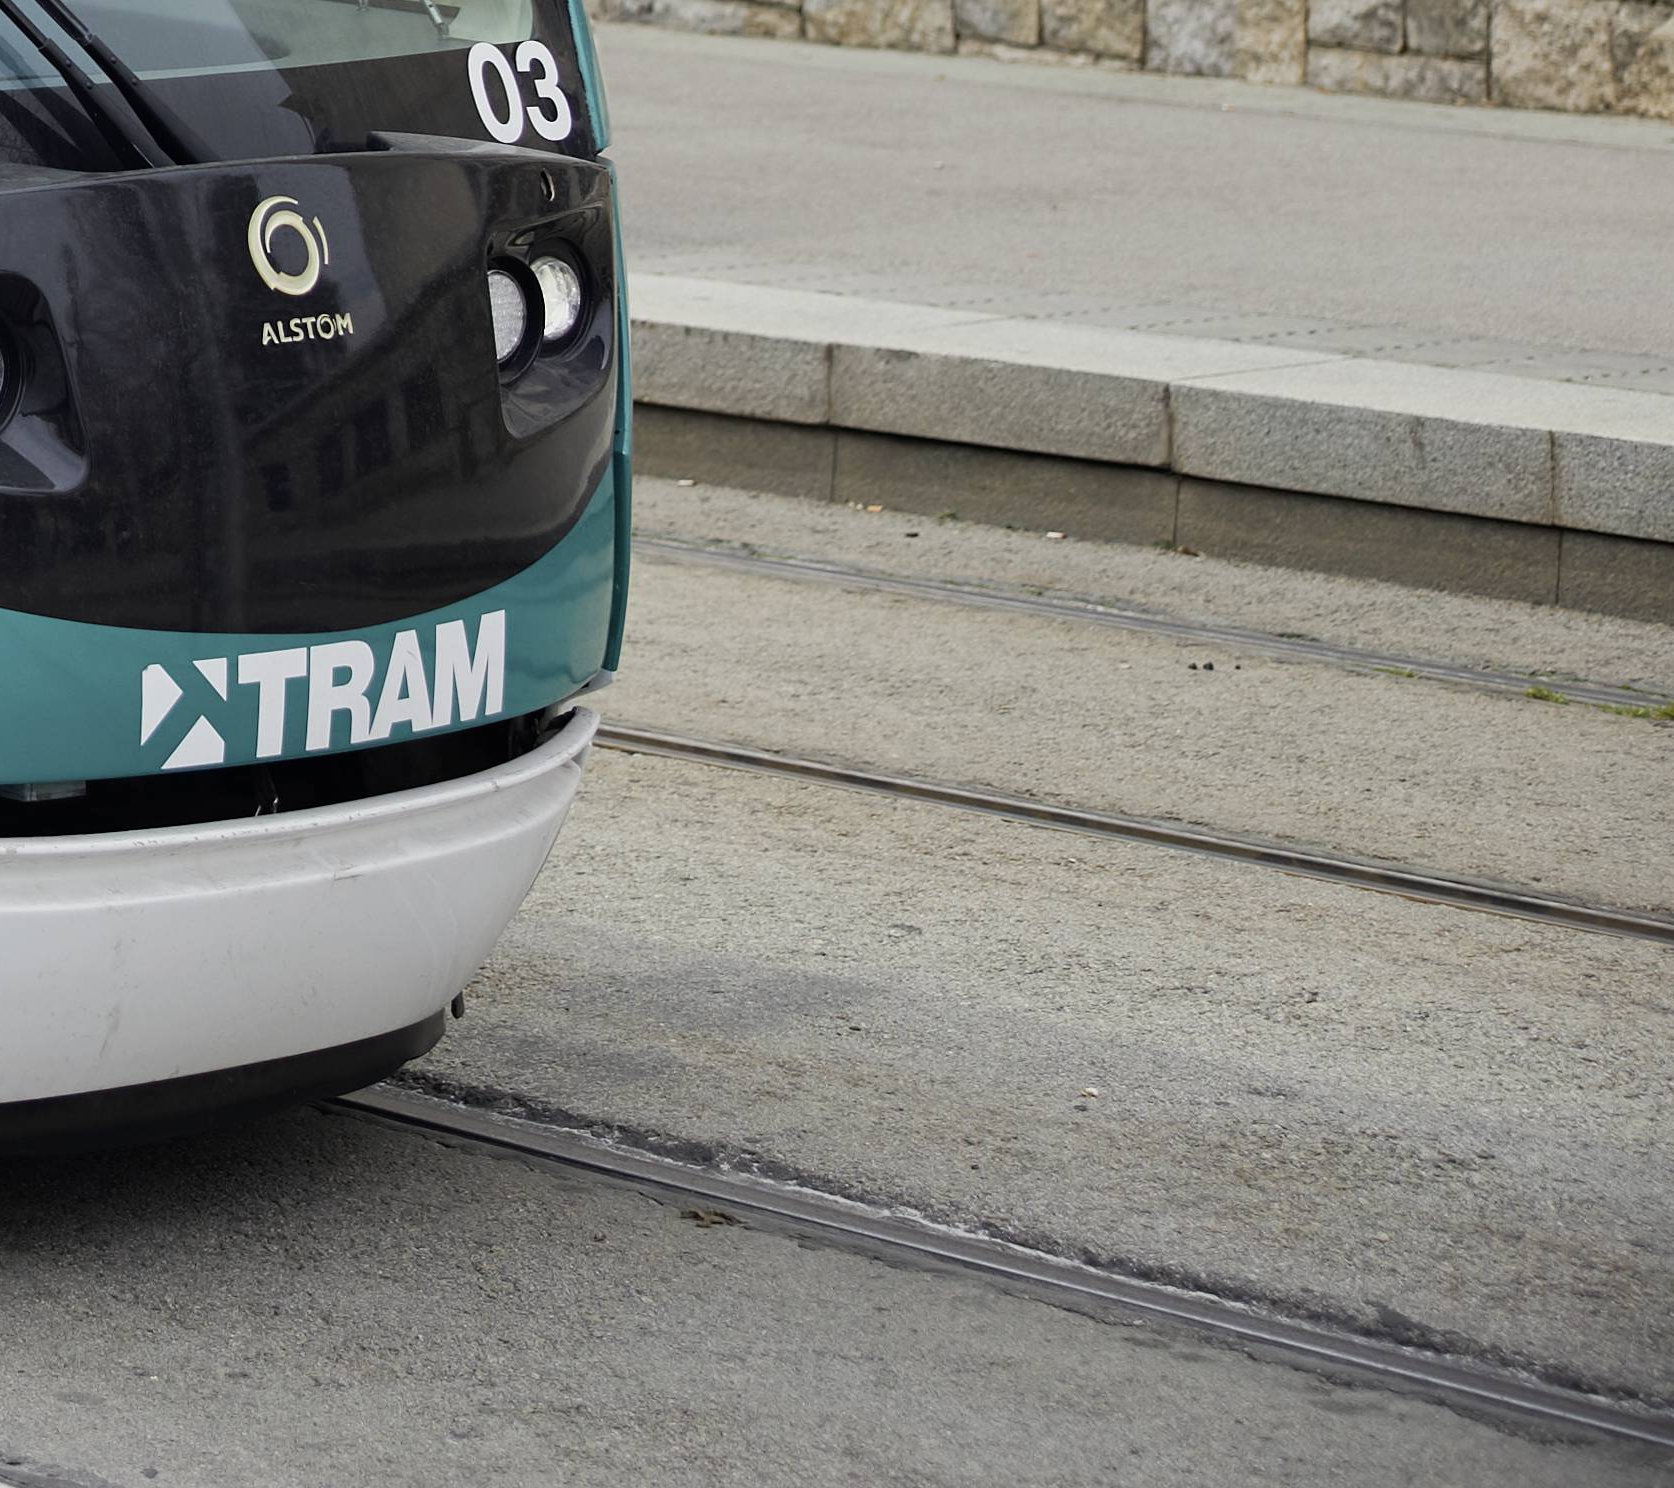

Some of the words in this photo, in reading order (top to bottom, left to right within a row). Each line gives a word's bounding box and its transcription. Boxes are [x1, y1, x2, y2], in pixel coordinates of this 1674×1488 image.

[467, 40, 573, 144] 03
[261, 313, 354, 346] ALSTOM
[238, 609, 507, 759] TRAM
